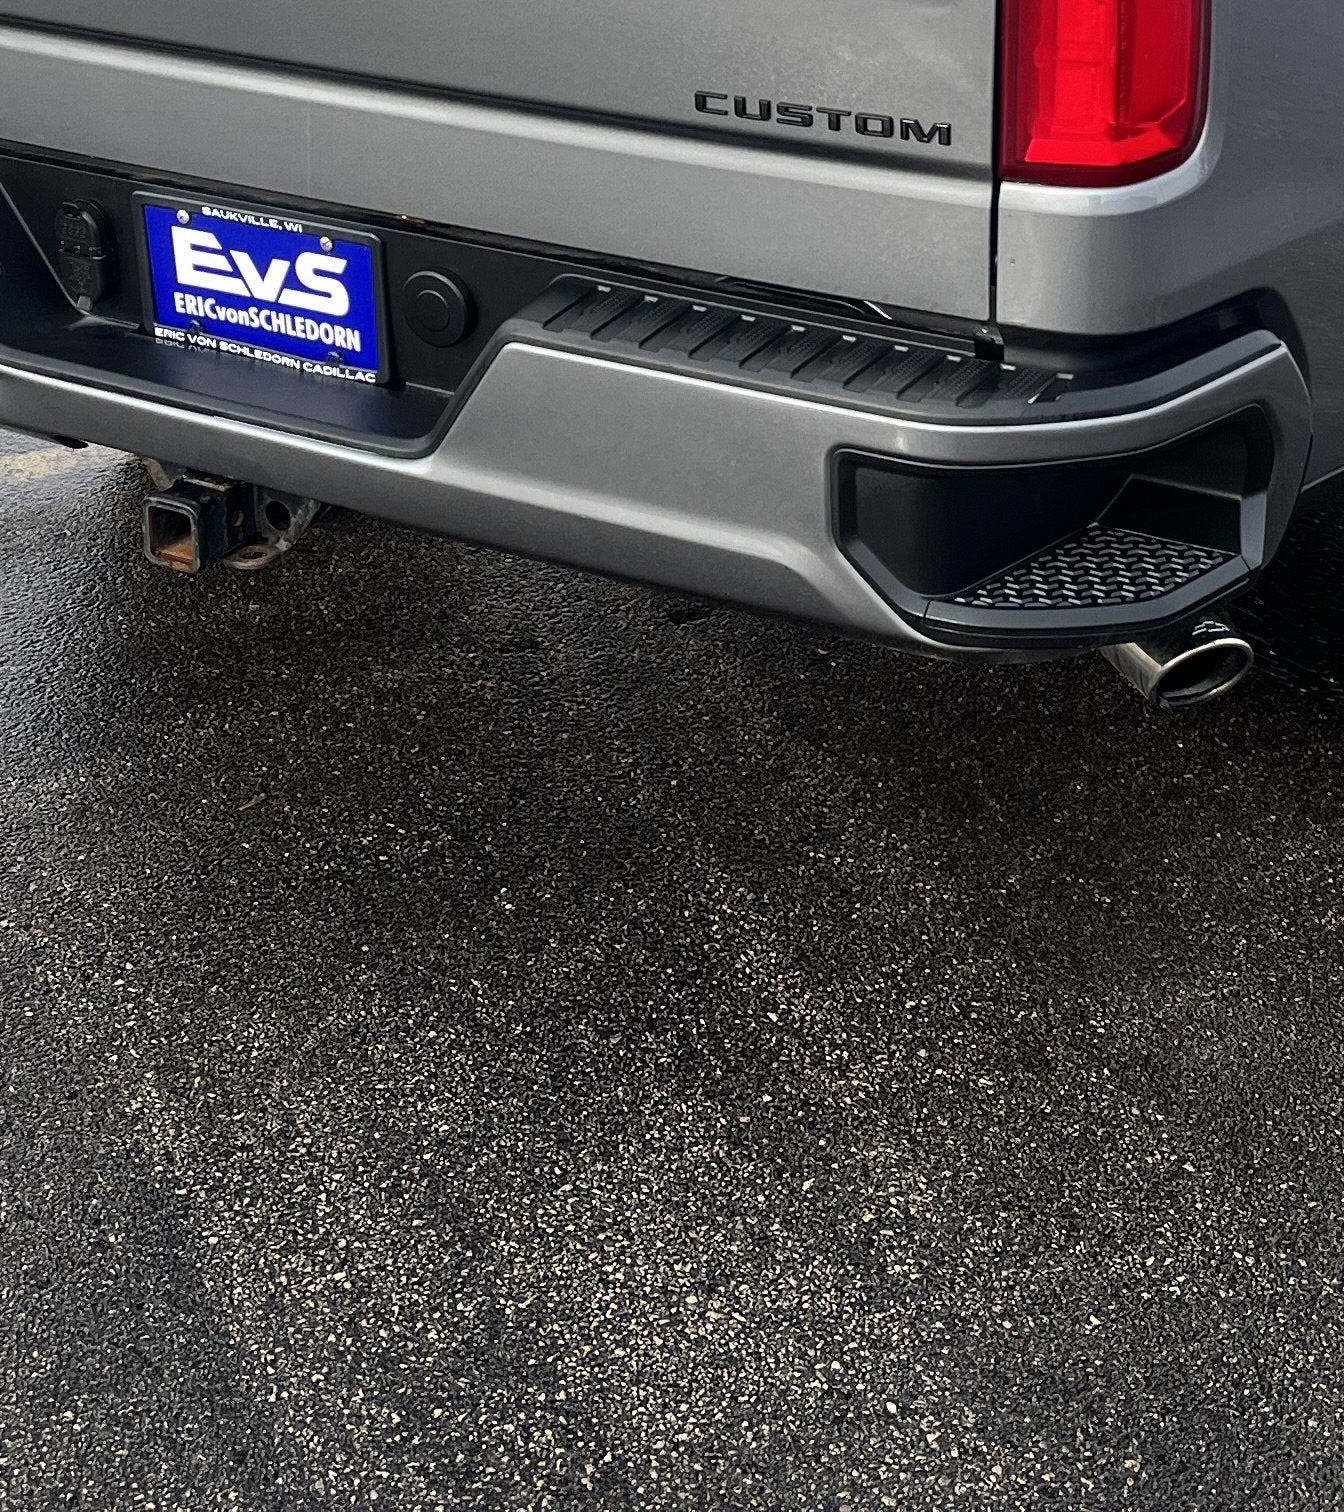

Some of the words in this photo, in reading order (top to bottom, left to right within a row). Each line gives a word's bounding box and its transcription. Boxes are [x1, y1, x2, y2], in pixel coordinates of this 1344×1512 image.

[693, 89, 953, 148] CUSTOM
[201, 206, 283, 231] SAUKVILLE,
[283, 221, 303, 234] WI
[153, 326, 186, 342] ERIC
[187, 333, 218, 350] VON
[218, 340, 301, 370] SCHLEDORN
[302, 361, 377, 384] CADILLAC
